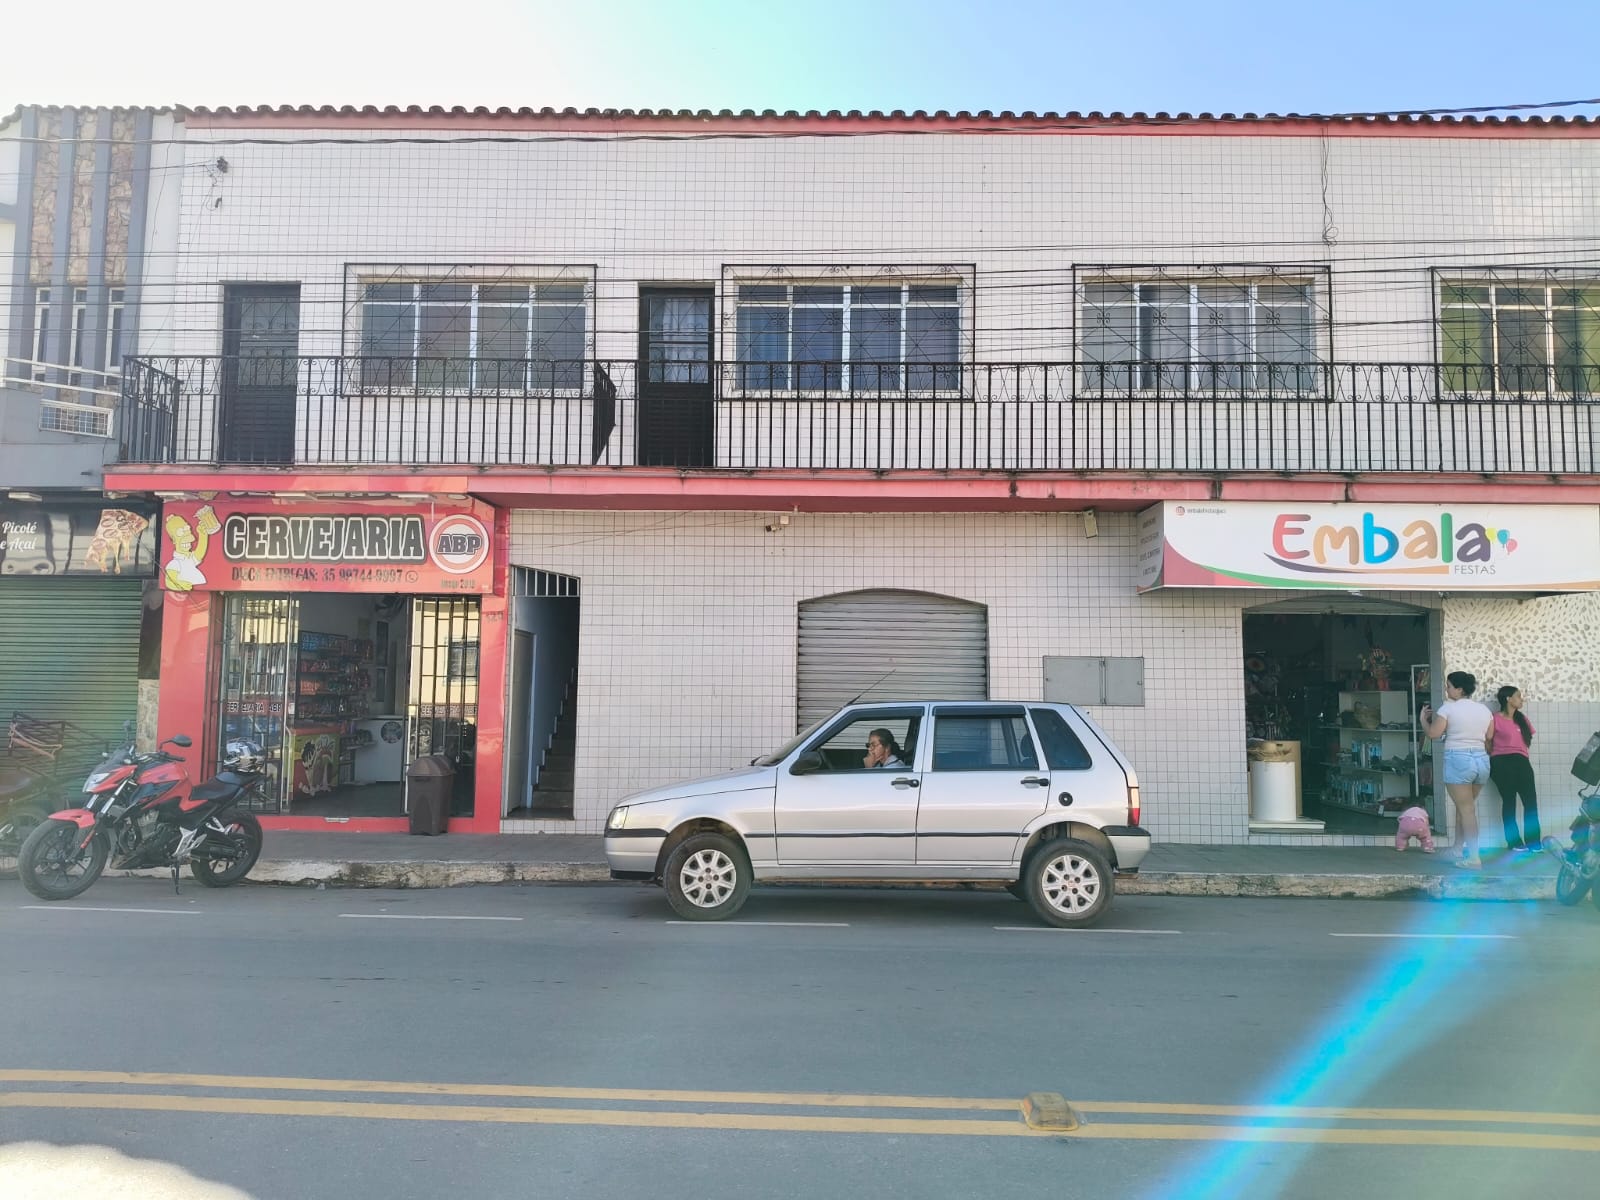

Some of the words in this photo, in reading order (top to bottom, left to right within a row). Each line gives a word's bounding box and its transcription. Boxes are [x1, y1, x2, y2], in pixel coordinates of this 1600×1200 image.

[2, 521, 37, 534] Picolé
[224, 514, 425, 560] CERVEJARIA
[437, 534, 481, 554] ABP
[1273, 512, 1491, 565] Embala
[0, 541, 7, 549] e
[322, 568, 336, 582] 35
[1454, 565, 1496, 574] FESTAS
